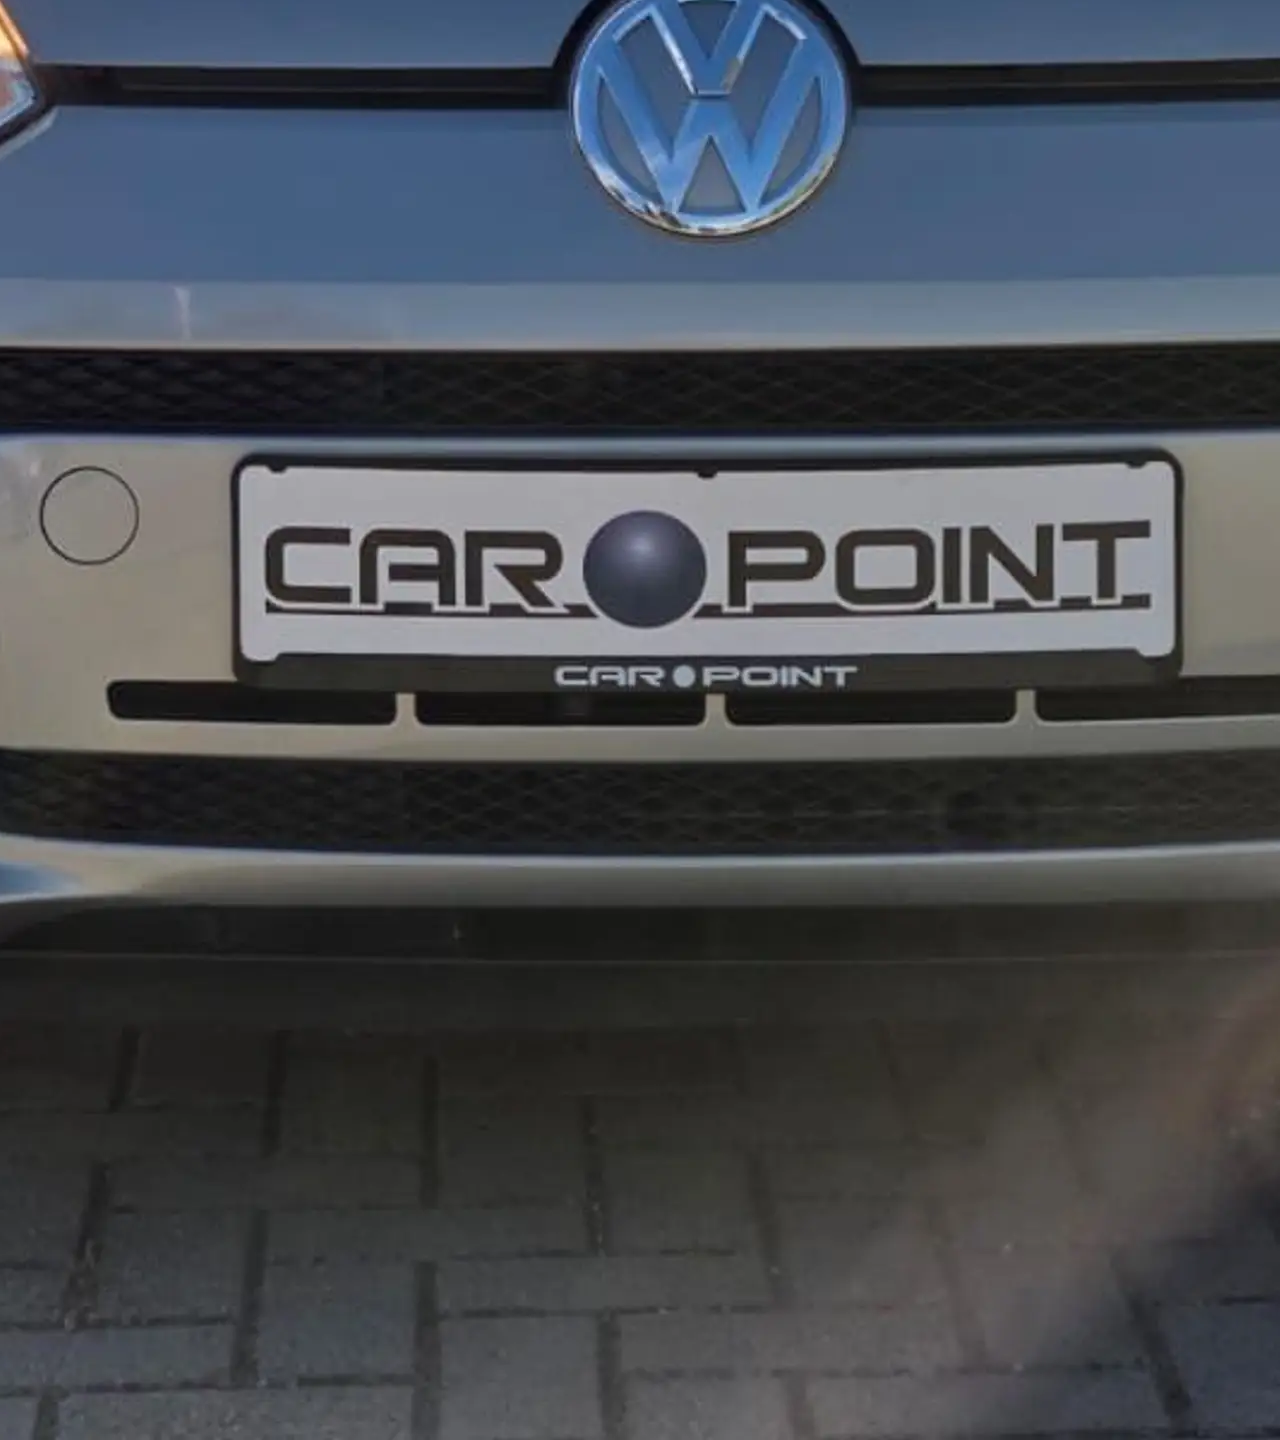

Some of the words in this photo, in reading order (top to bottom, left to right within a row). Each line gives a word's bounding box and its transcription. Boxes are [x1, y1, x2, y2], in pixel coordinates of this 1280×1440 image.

[264, 525, 568, 611] CAR
[728, 520, 1151, 611] POINT
[553, 665, 665, 687] CAR
[702, 665, 859, 687] POINT
